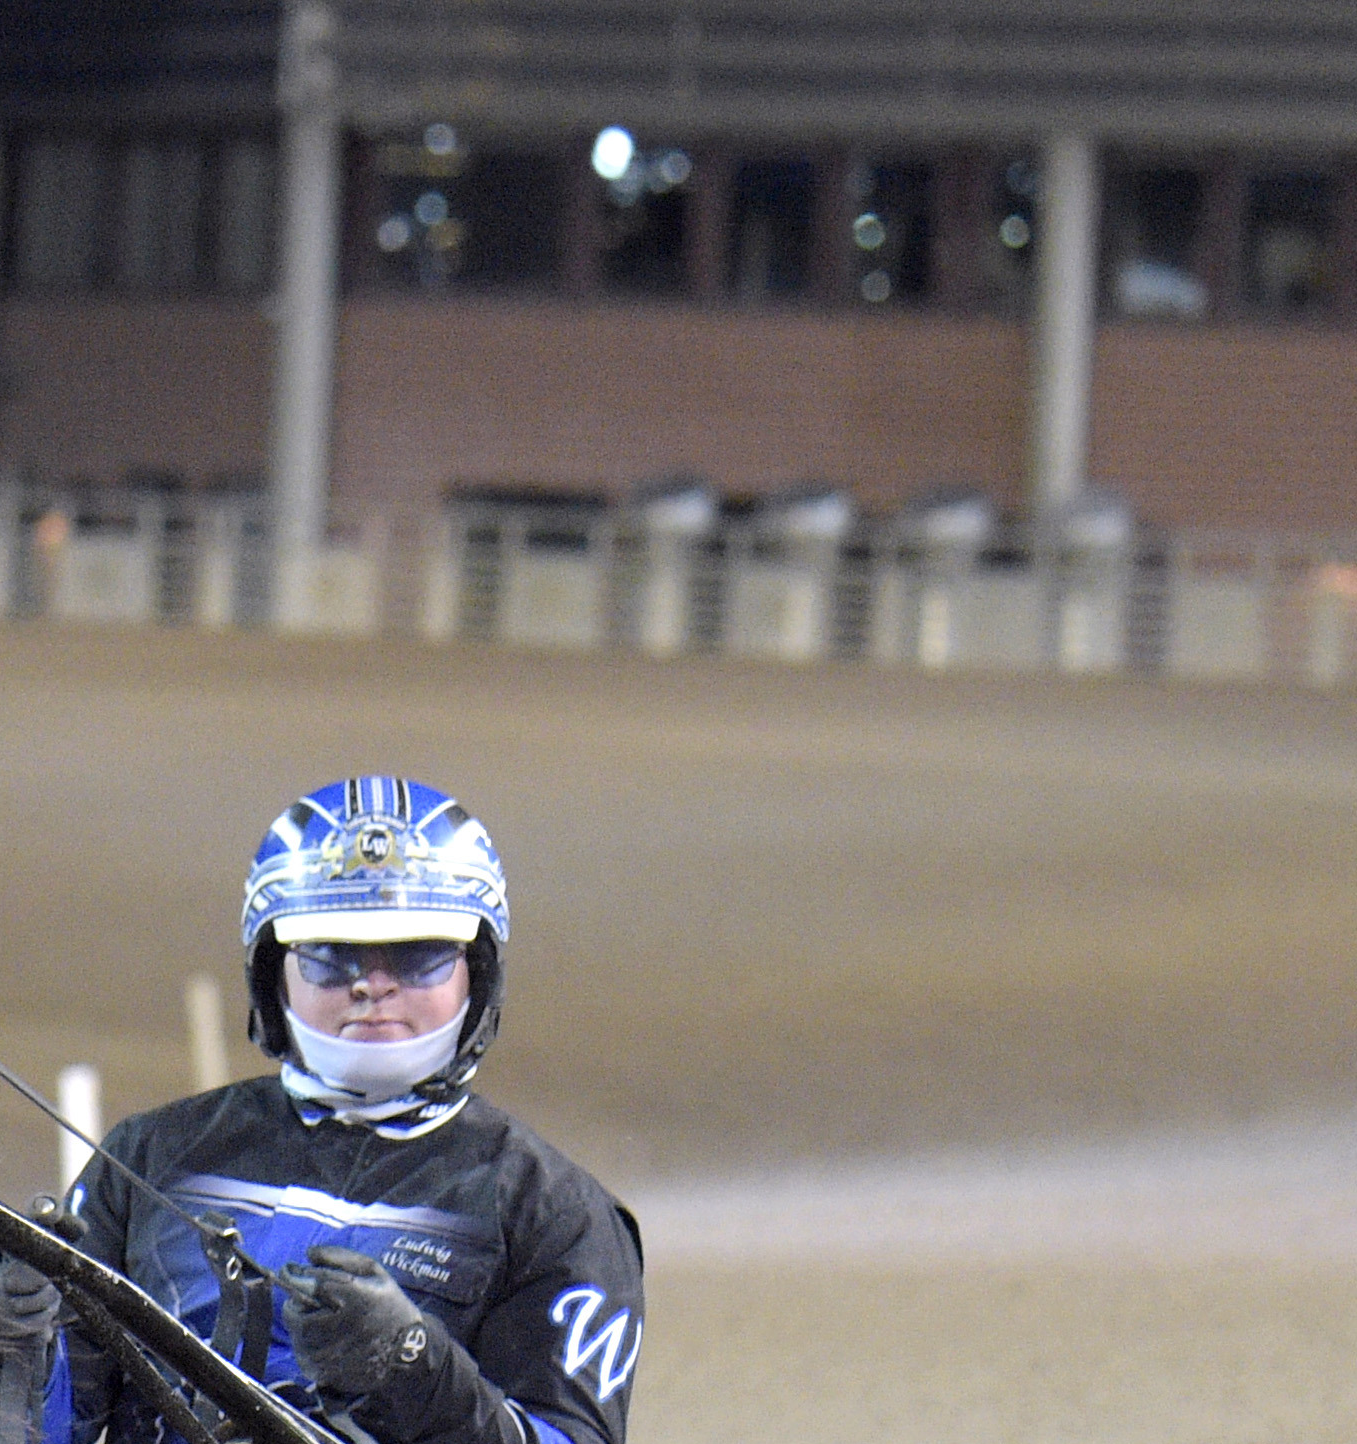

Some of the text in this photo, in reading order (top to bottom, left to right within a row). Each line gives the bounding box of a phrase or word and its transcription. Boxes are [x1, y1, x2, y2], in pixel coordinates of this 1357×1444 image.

[392, 1236, 453, 1264] Ludwig
[381, 1251, 451, 1283] Wickman
[550, 1285, 643, 1402] W
